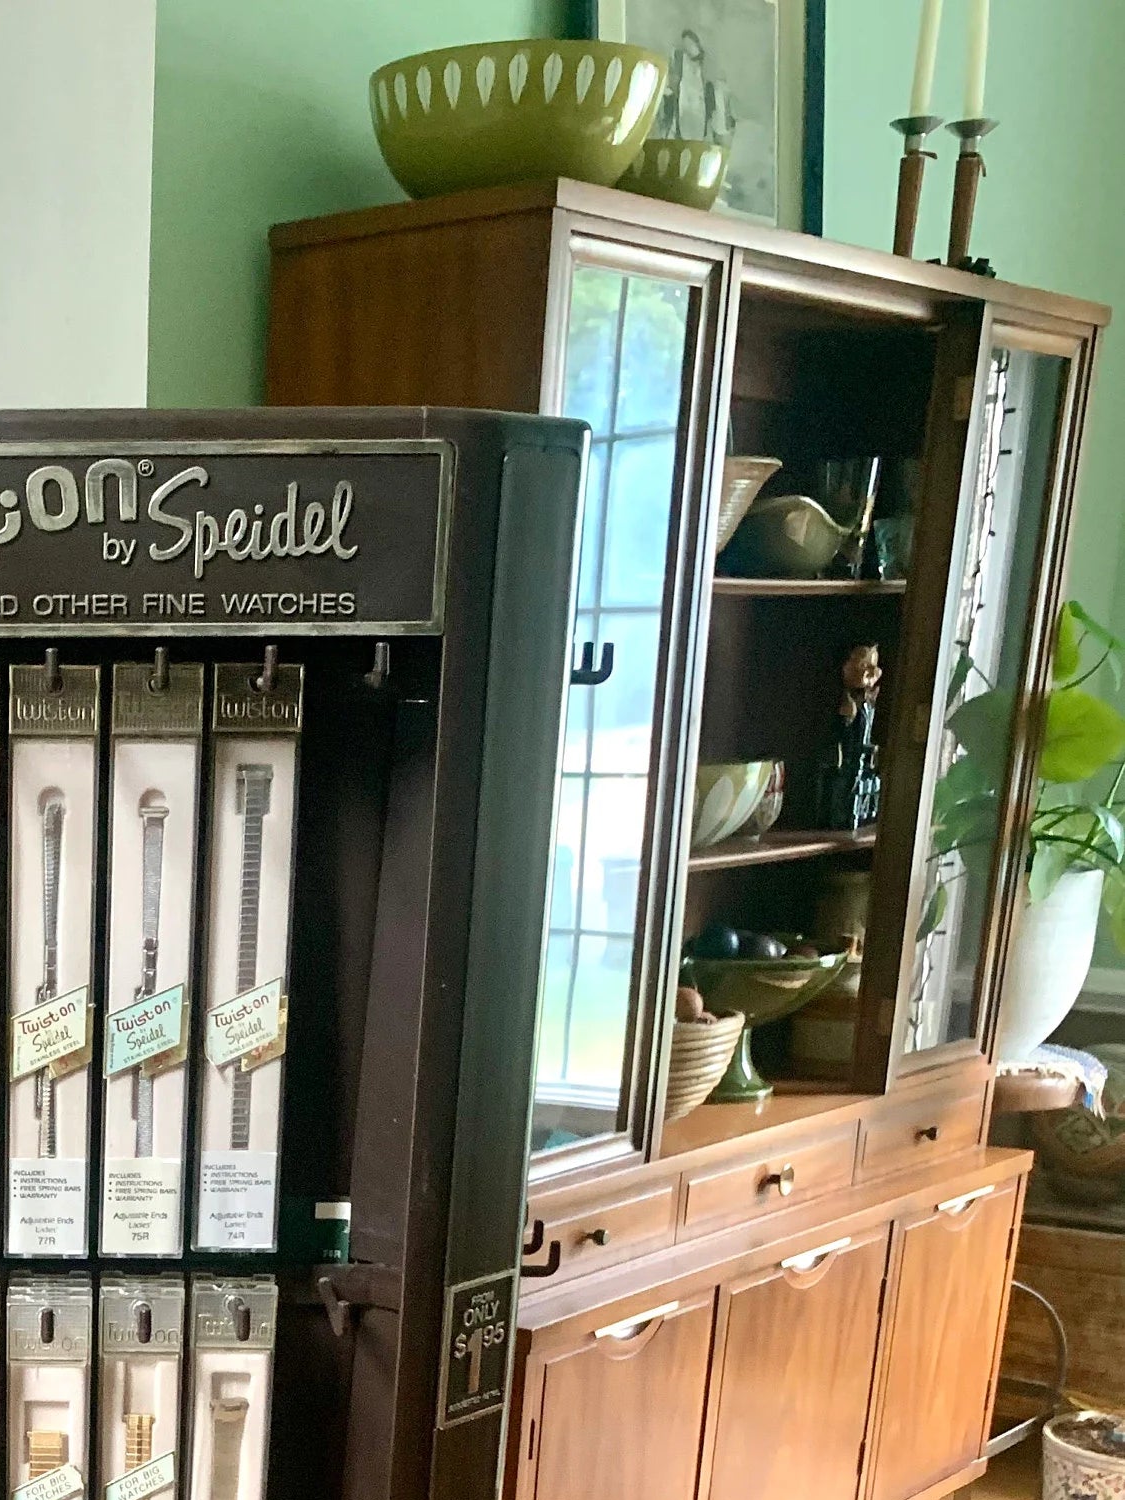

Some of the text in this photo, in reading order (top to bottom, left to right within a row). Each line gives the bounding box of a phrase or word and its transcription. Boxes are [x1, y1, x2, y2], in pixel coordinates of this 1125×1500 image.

[102, 530, 136, 566] by
[148, 465, 359, 579] Speidel
[32, 594, 129, 616] OTHER
[142, 593, 206, 615] FINE
[222, 593, 356, 615] WATCHES
[126, 1023, 166, 1051] Speidel
[225, 1018, 266, 1046] Speidel
[56, 1216, 74, 1224] Ends
[150, 1211, 168, 1219] Ends
[38, 1236, 56, 1246] 77R
[131, 1231, 150, 1241] 75R
[463, 1299, 501, 1327] ONLY
[24, 1473, 68, 1500] FOR BIG
[119, 1464, 161, 1493] FOR BIG
